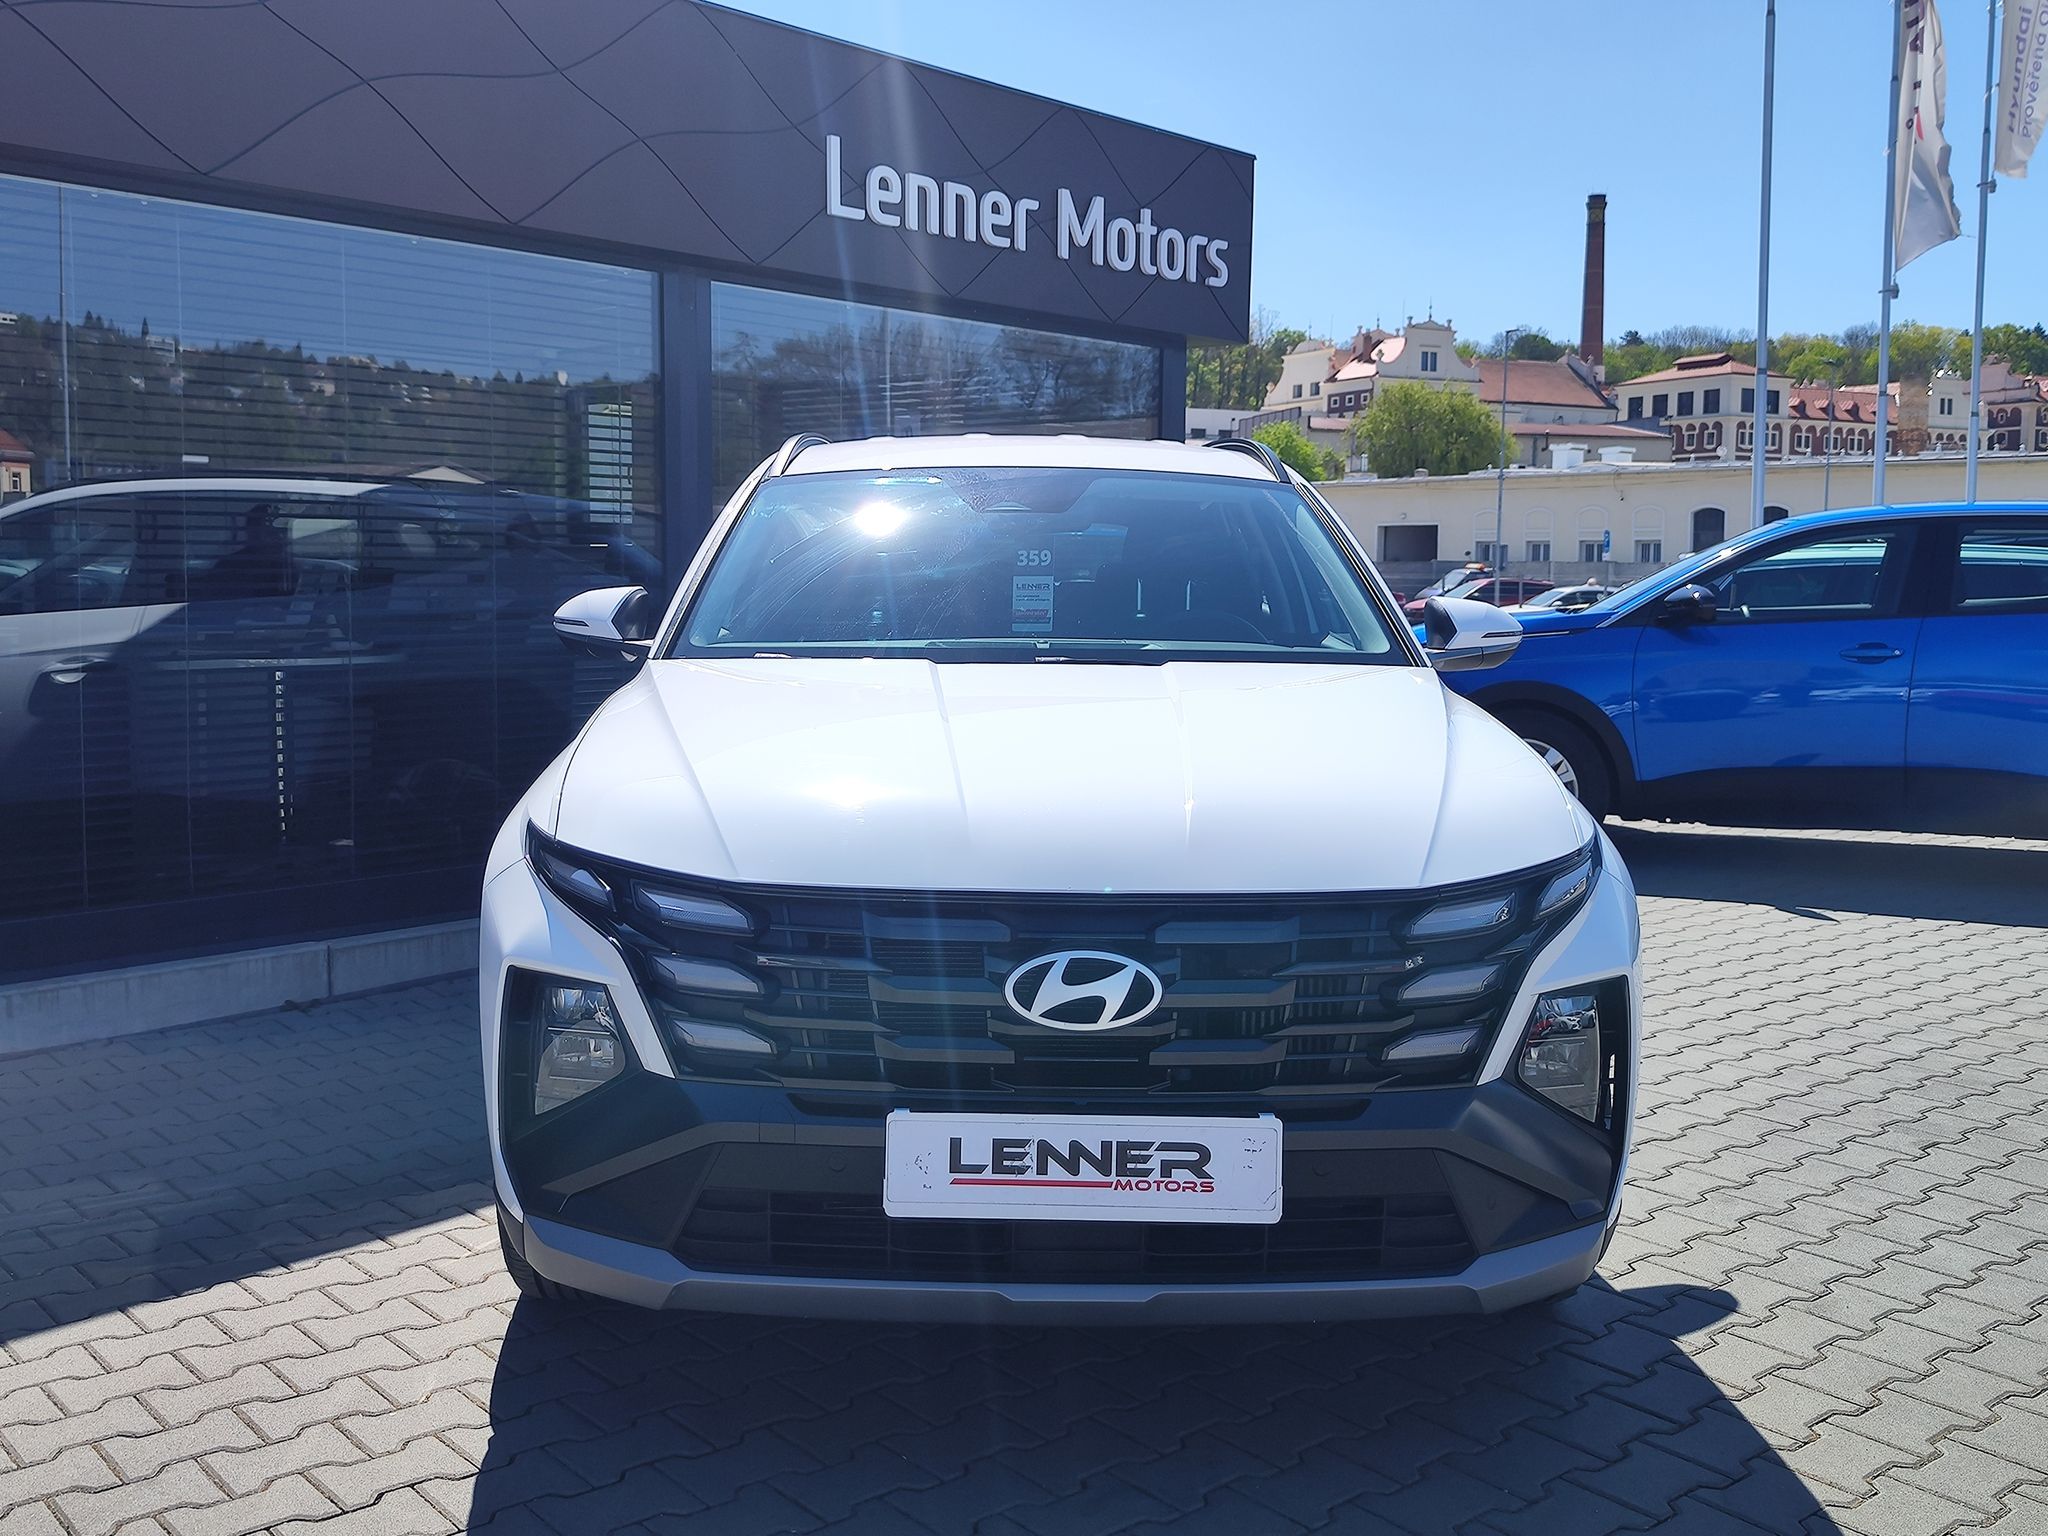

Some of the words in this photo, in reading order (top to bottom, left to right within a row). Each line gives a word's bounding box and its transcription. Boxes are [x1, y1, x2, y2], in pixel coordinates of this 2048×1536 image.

[2008, 6, 2033, 134] Hyundai
[2021, 32, 2047, 138] Prověřená
[826, 134, 1039, 252] Lenner
[1056, 188, 1229, 288] Motors
[1017, 549, 1052, 567] 359
[948, 1137, 1215, 1180] LENNER
[1112, 1178, 1216, 1194] MOTORS
